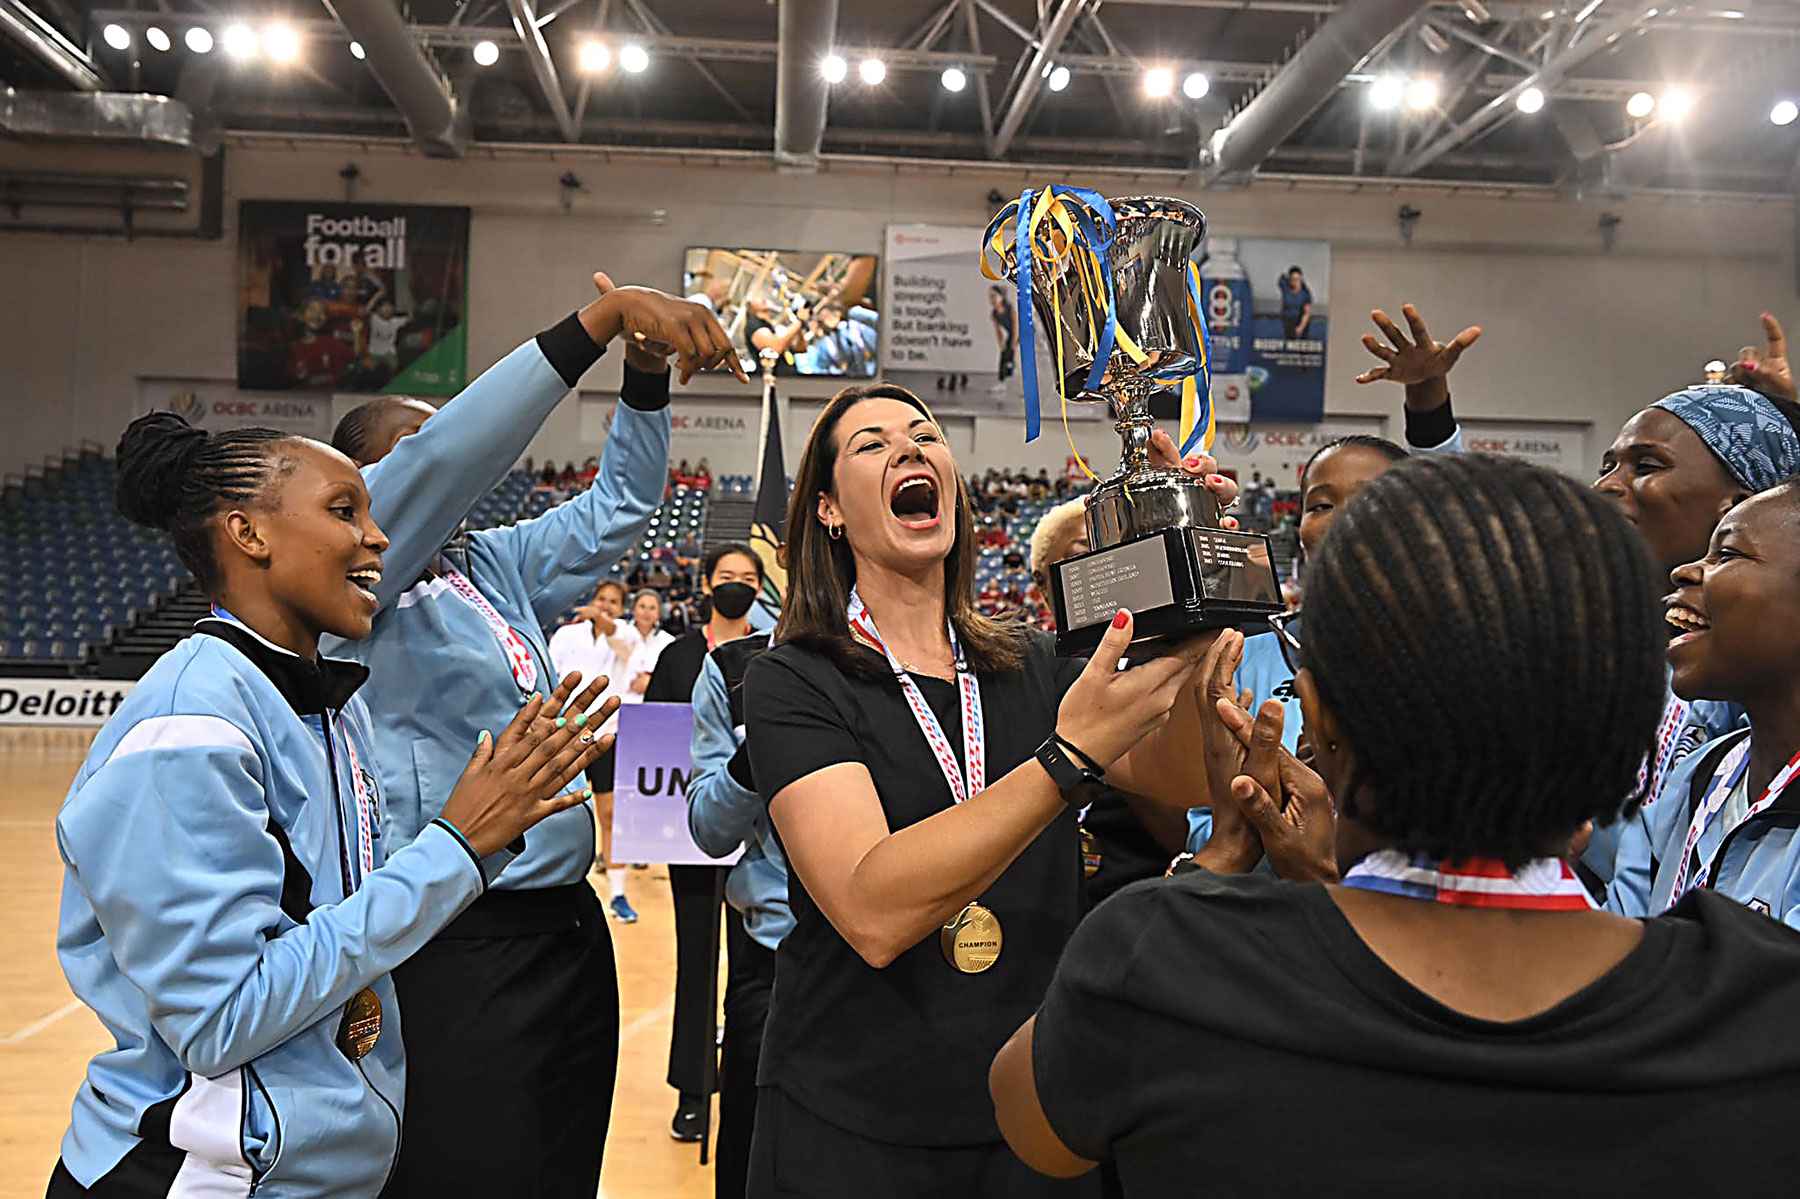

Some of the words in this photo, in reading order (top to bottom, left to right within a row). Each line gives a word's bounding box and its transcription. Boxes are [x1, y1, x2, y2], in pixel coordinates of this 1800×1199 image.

[307, 214, 405, 236] Football
[303, 235, 360, 267] for
[364, 238, 405, 269] all
[894, 274, 946, 289] Building
[894, 290, 946, 304] strength
[893, 306, 902, 316] is
[892, 320, 912, 331] But
[917, 320, 968, 334] banking
[892, 334, 938, 347] doesn't
[942, 335, 972, 348] have
[891, 350, 905, 360] to
[212, 402, 257, 416] OCBC
[262, 402, 315, 416] ARENA
[694, 416, 746, 430] ARENA
[1265, 431, 1304, 446] OCBC
[1469, 439, 1507, 451] OCBC
[1513, 440, 1561, 453] ARENA
[958, 941, 998, 949] CHAMPION
